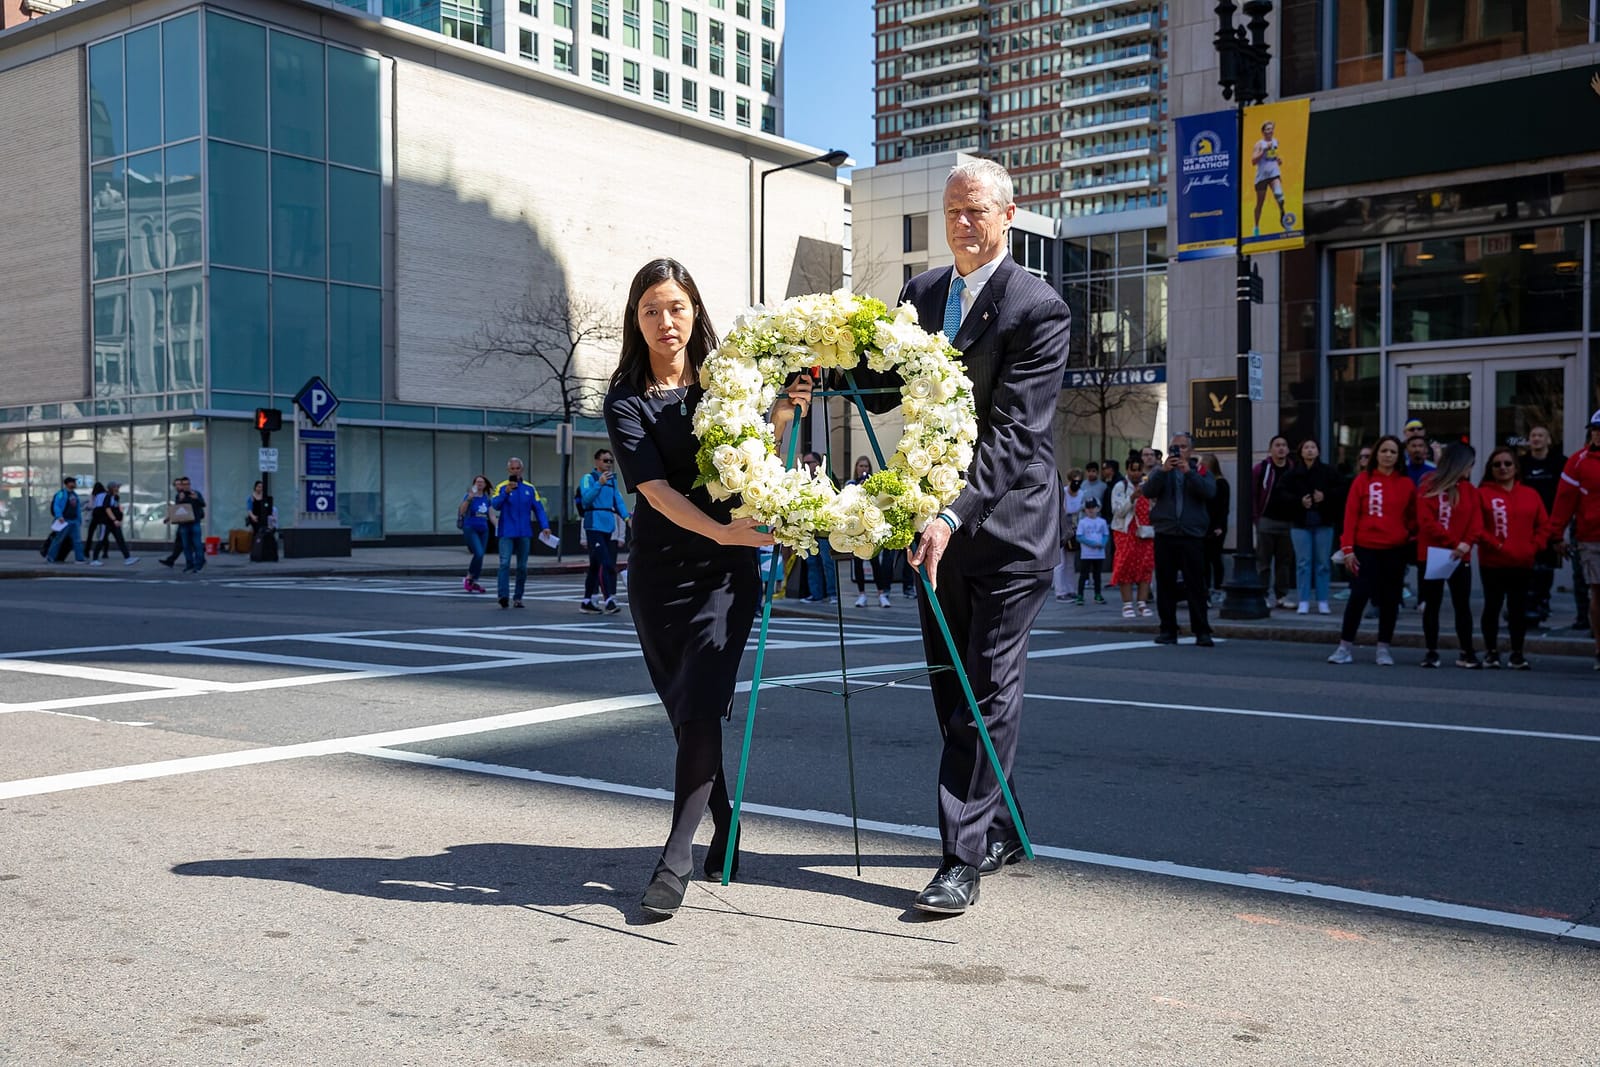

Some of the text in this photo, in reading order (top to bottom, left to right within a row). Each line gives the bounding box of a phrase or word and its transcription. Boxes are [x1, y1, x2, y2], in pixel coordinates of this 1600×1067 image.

[1198, 153, 1230, 163] BOSTON
[1183, 160, 1230, 171] MARATHON
[311, 389, 327, 414] P
[310, 489, 334, 497] Parking
